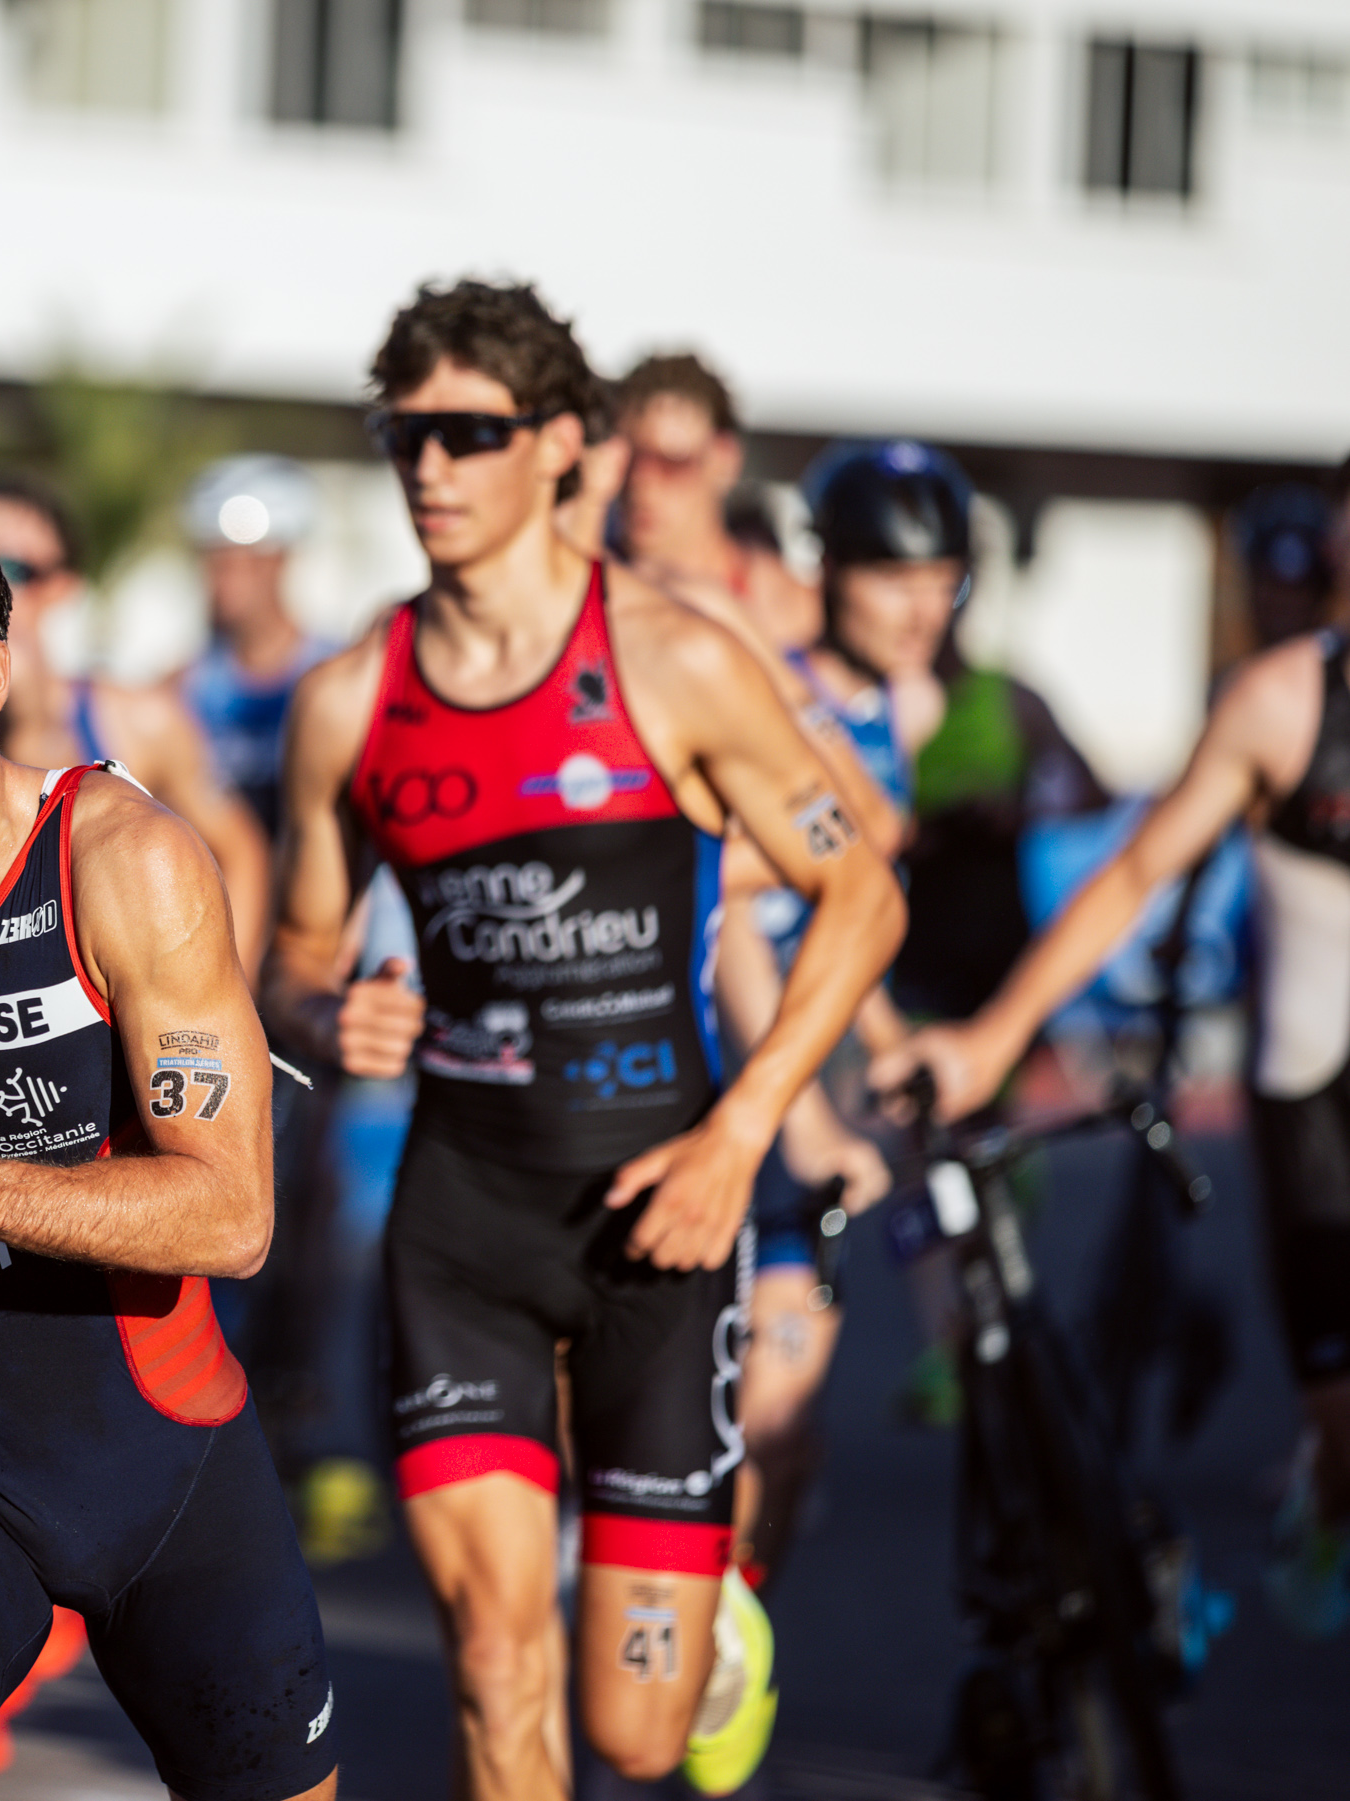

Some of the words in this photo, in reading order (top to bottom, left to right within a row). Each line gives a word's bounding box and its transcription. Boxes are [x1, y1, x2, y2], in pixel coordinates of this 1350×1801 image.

[149, 1068, 231, 1122] 37
[1, 1150, 37, 1159] Pyrénées
[45, 1132, 100, 1152] Méditerranée
[9, 1128, 47, 1142] Région
[616, 1621, 684, 1684] 41
